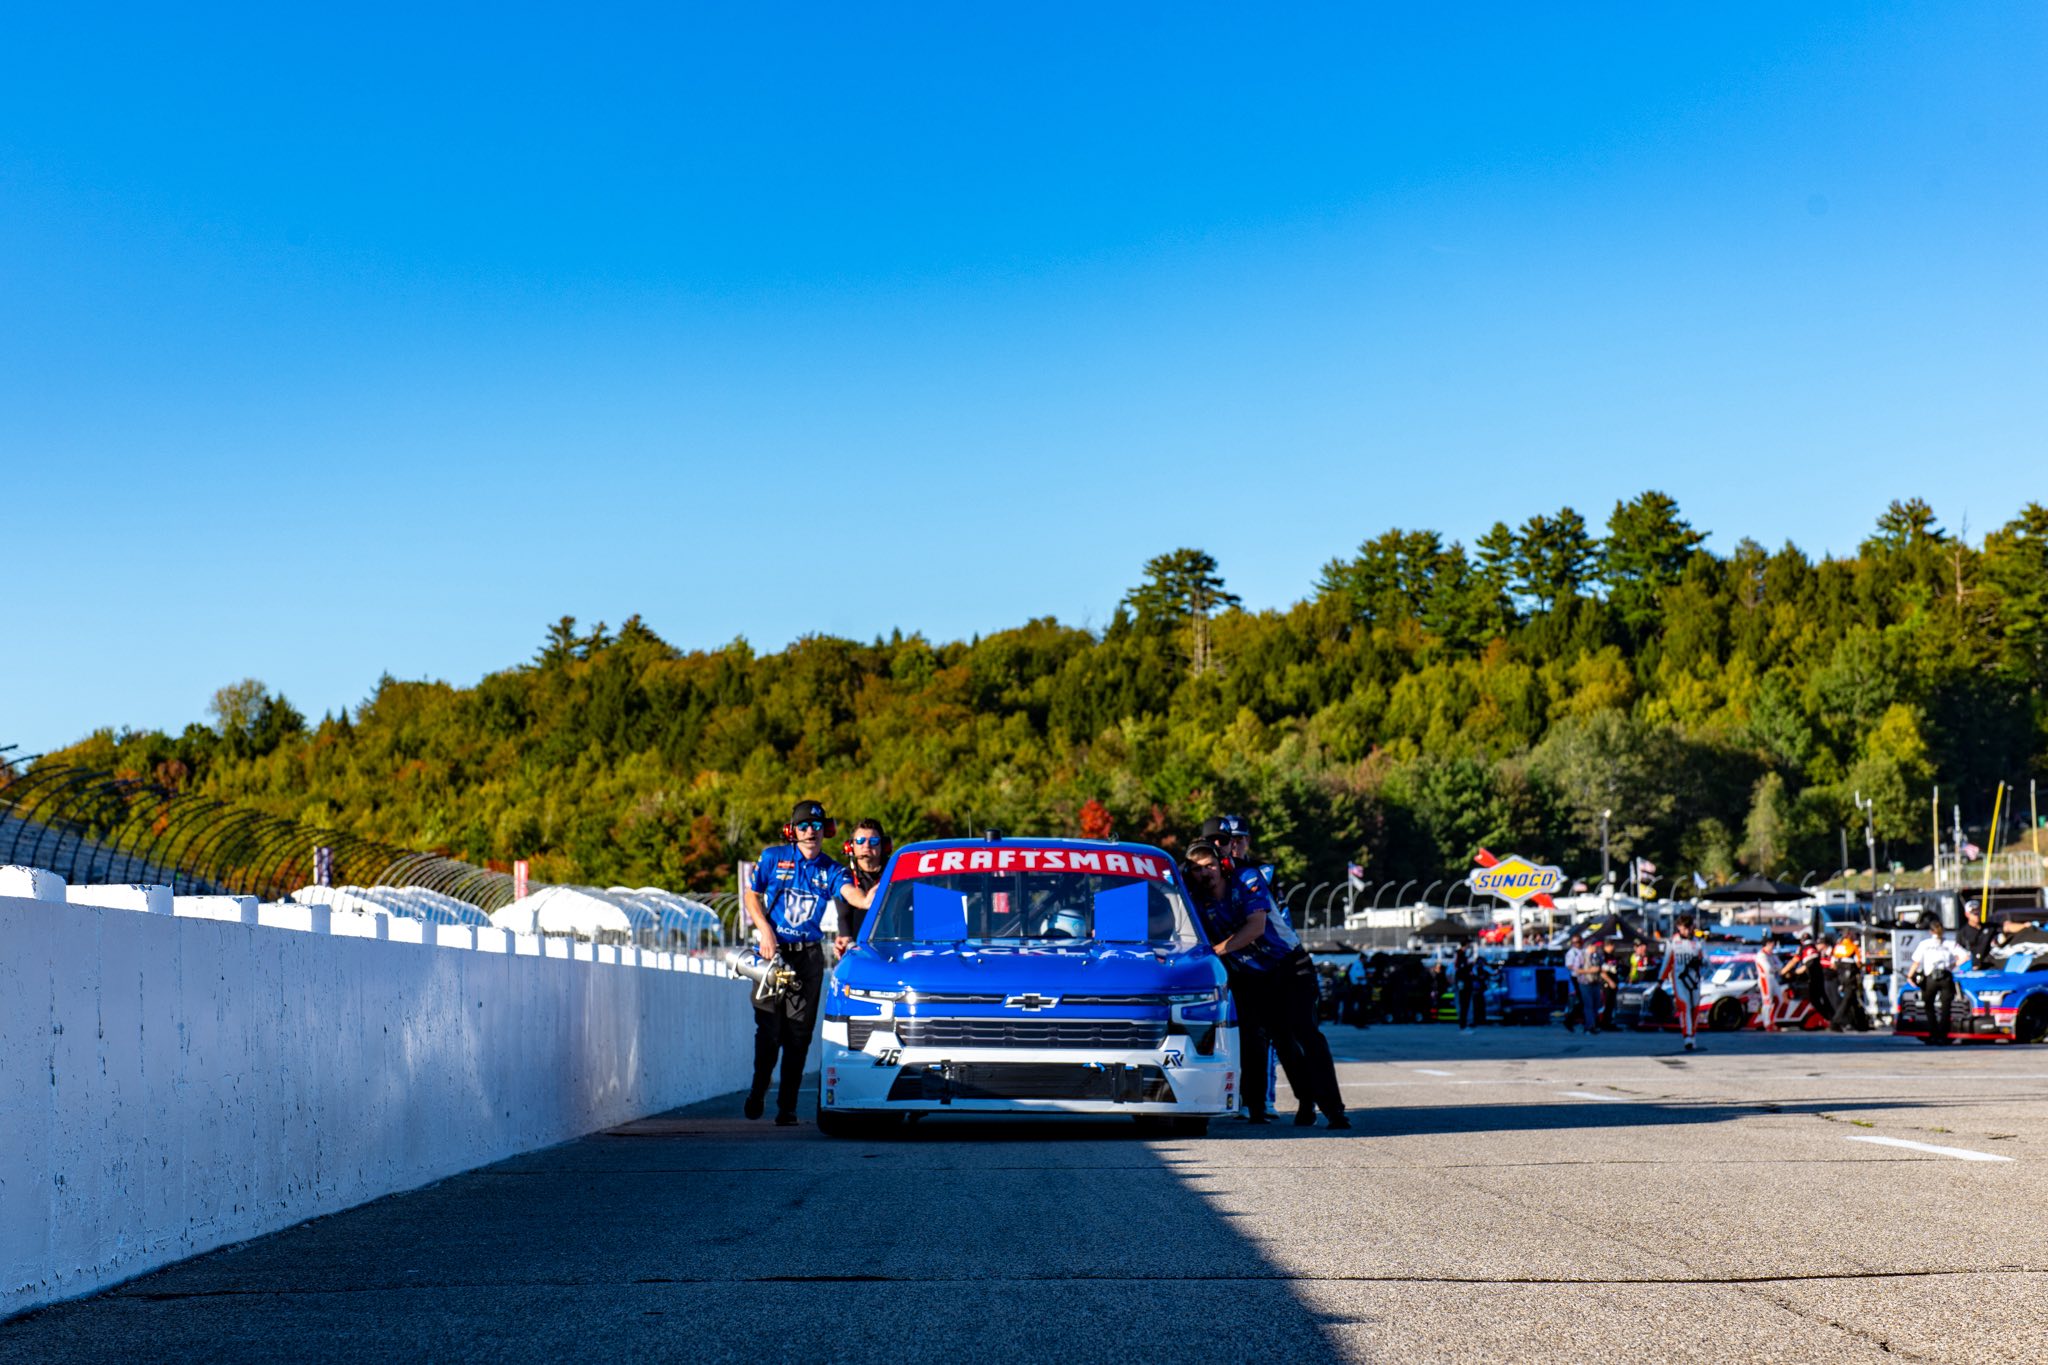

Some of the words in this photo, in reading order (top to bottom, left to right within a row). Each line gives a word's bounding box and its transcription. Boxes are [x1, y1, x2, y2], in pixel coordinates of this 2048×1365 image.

[917, 849, 1158, 877] CRAFTSMAN
[1478, 873, 1554, 888] SUNOCO
[873, 1048, 902, 1067] 26
